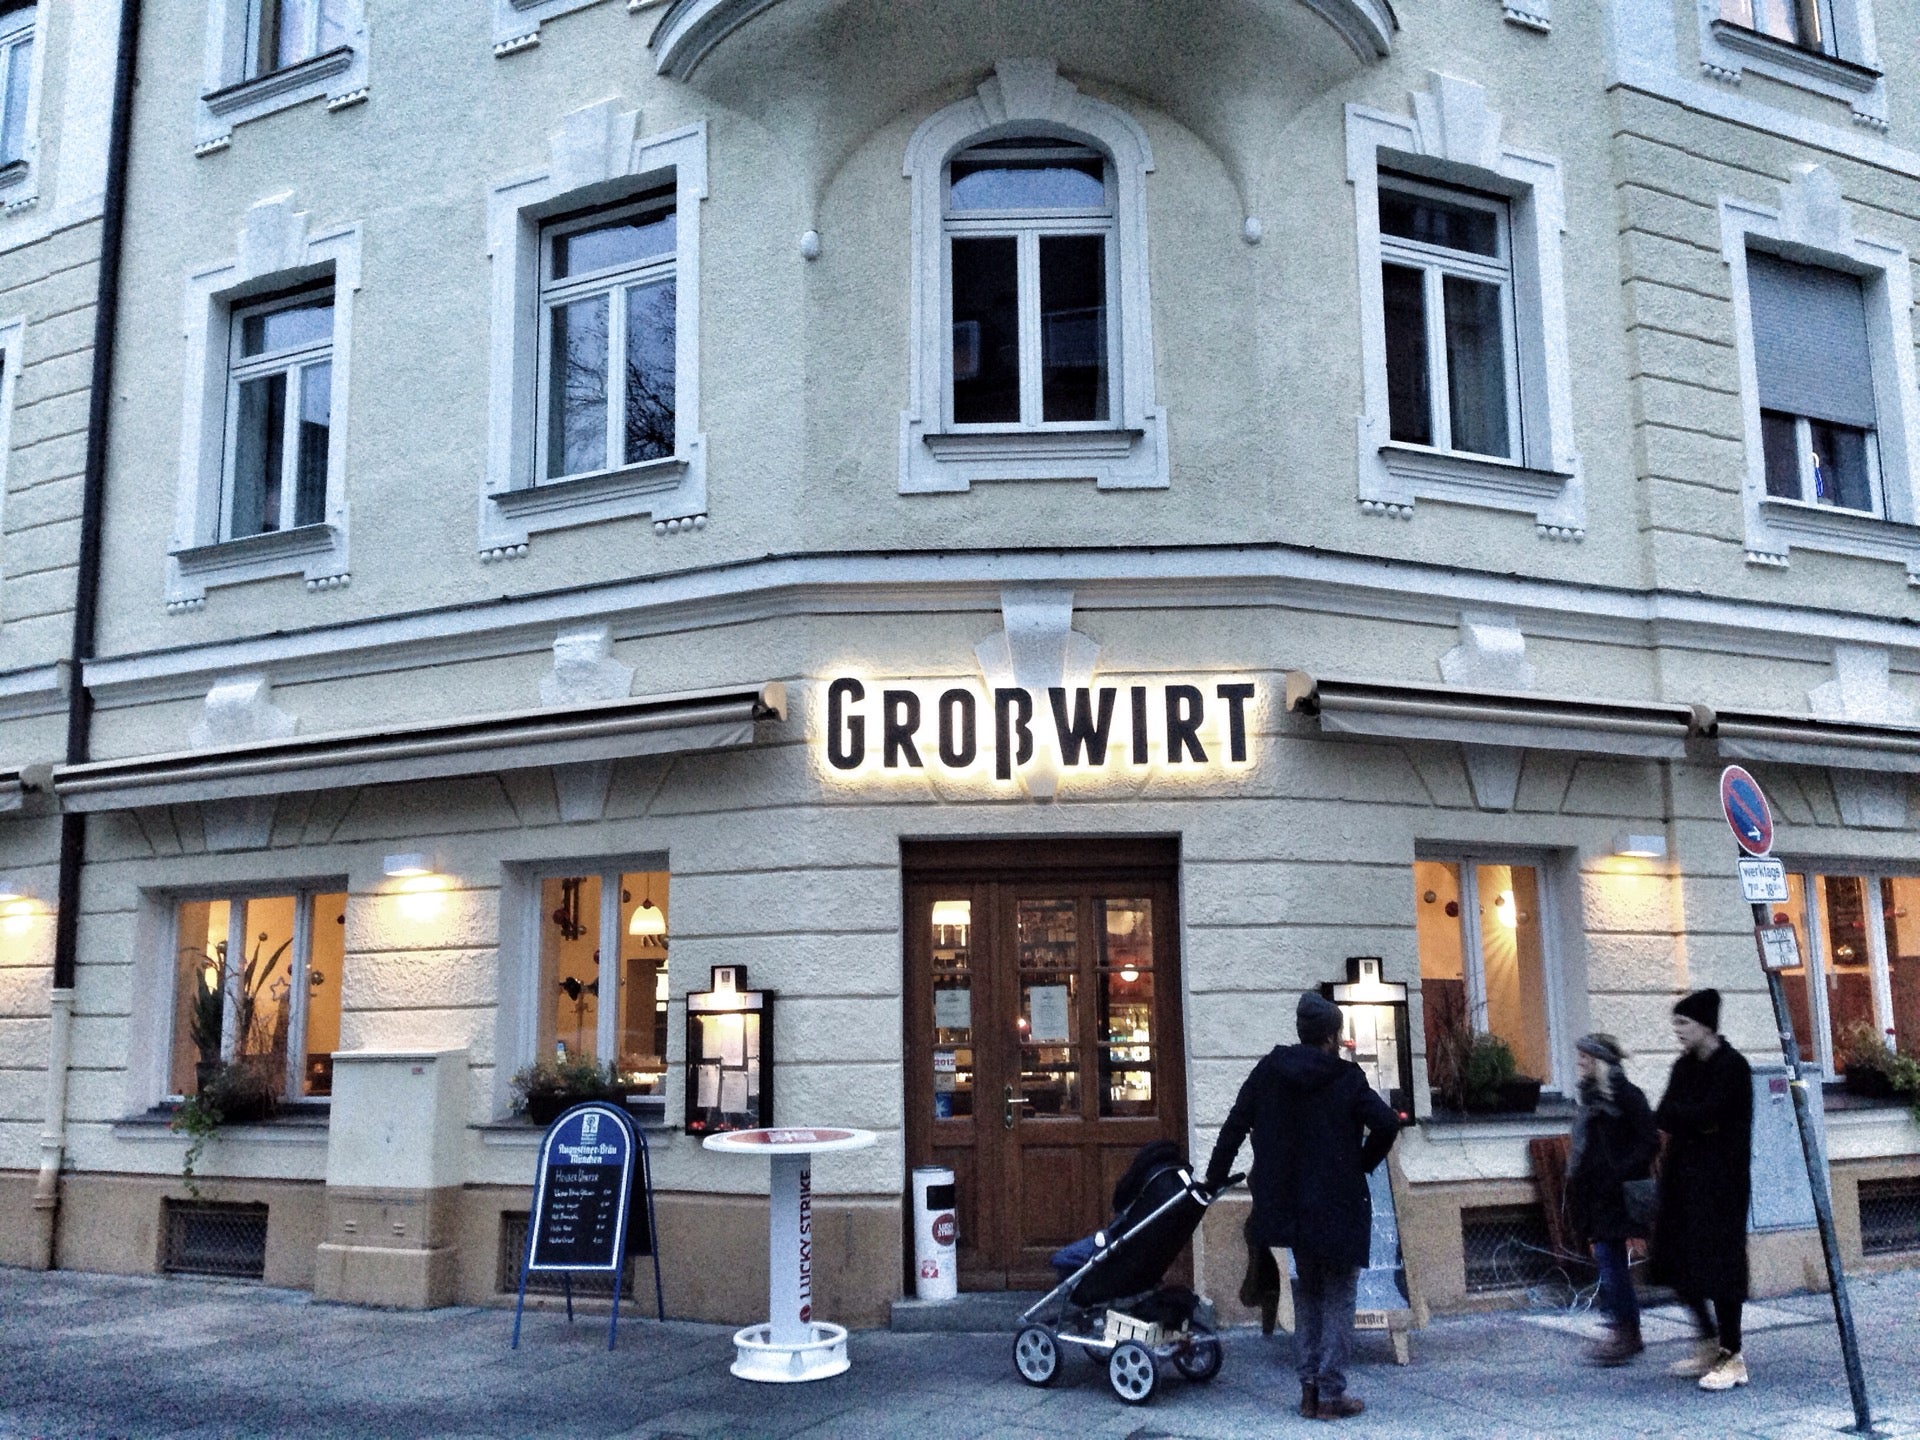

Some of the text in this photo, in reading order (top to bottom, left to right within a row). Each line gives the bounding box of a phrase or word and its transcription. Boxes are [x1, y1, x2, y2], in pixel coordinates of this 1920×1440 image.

[1742, 864, 1780, 881] werktags
[799, 1168, 811, 1300] LUCKY STRIKE
